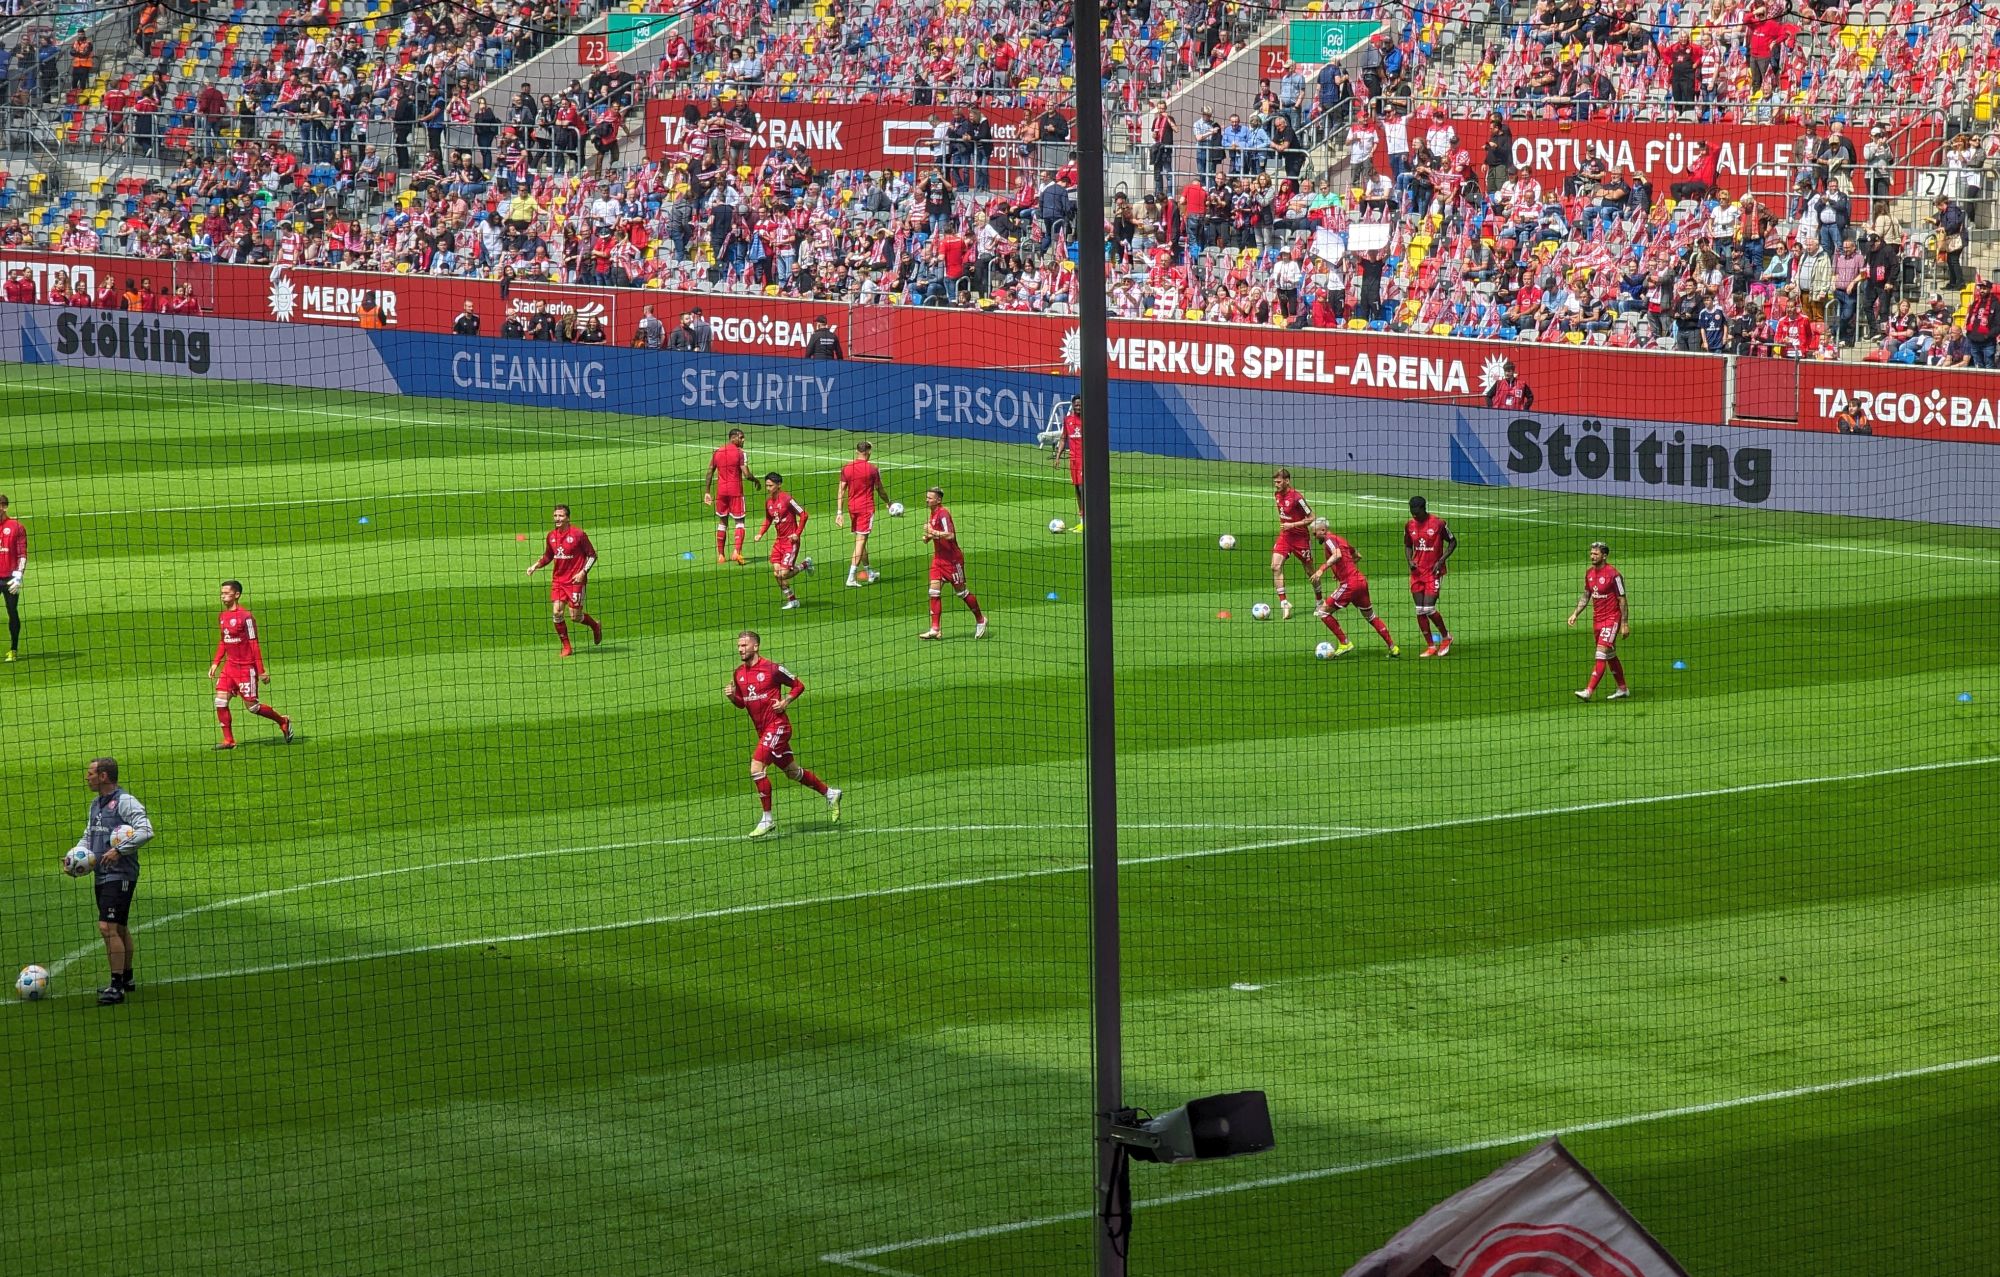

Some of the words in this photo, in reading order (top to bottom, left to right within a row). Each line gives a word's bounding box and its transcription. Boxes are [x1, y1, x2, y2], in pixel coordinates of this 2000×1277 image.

[586, 41, 604, 60] 23
[1267, 51, 1285, 73] 25
[769, 119, 842, 150] BANK
[1717, 142, 1793, 177] ALLE
[1926, 173, 1947, 196] 27
[57, 311, 211, 374] Stölting
[452, 351, 606, 399] CLEANING
[1107, 337, 1236, 377] MERKUR
[1242, 345, 1470, 394] SPIEL-ARENA
[681, 367, 835, 414] SECURITY
[1813, 387, 1921, 424] TARGO
[1951, 396, 2000, 429] BA
[1506, 418, 1772, 503] Stölting
[1600, 627, 1611, 638] 25
[239, 683, 251, 693] 23
